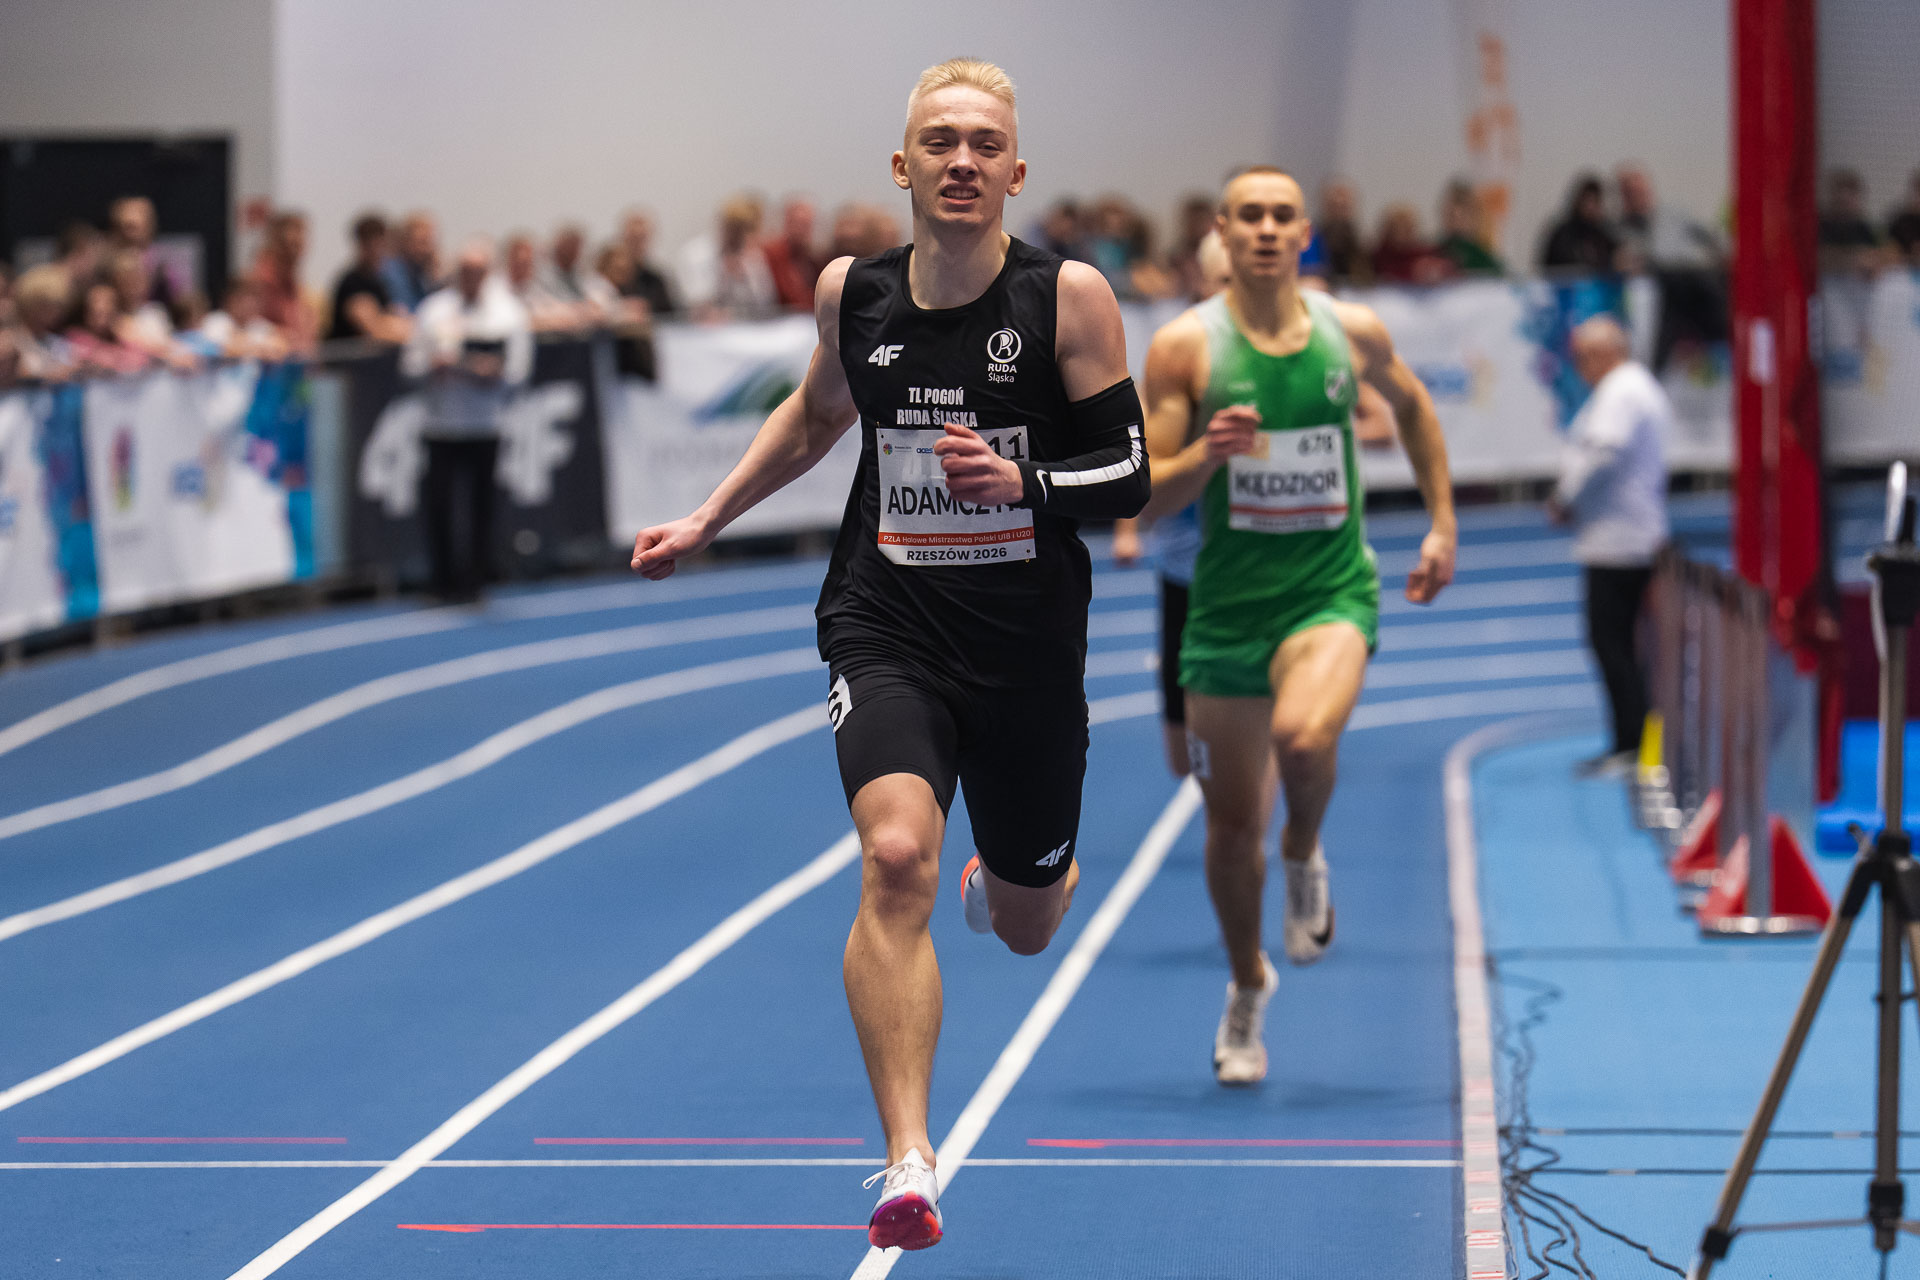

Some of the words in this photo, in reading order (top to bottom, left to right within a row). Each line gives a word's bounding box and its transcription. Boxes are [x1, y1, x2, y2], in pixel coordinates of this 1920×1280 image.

[868, 344, 905, 366] 4F
[987, 363, 1017, 373] RUDA
[988, 371, 1015, 383] Śląska
[908, 387, 922, 403] TL
[924, 386, 964, 406] POGOŃ
[896, 409, 931, 425] RUDA
[883, 535, 901, 543] PZLA
[902, 536, 927, 544] Halowe
[928, 536, 973, 544] Mistrzostwa
[974, 534, 997, 543] Polski
[998, 533, 1011, 541] U18
[1016, 530, 1031, 539] U20
[906, 548, 970, 561] RZESZÓW
[973, 547, 1008, 560] 2026
[1035, 839, 1070, 868] 4F
